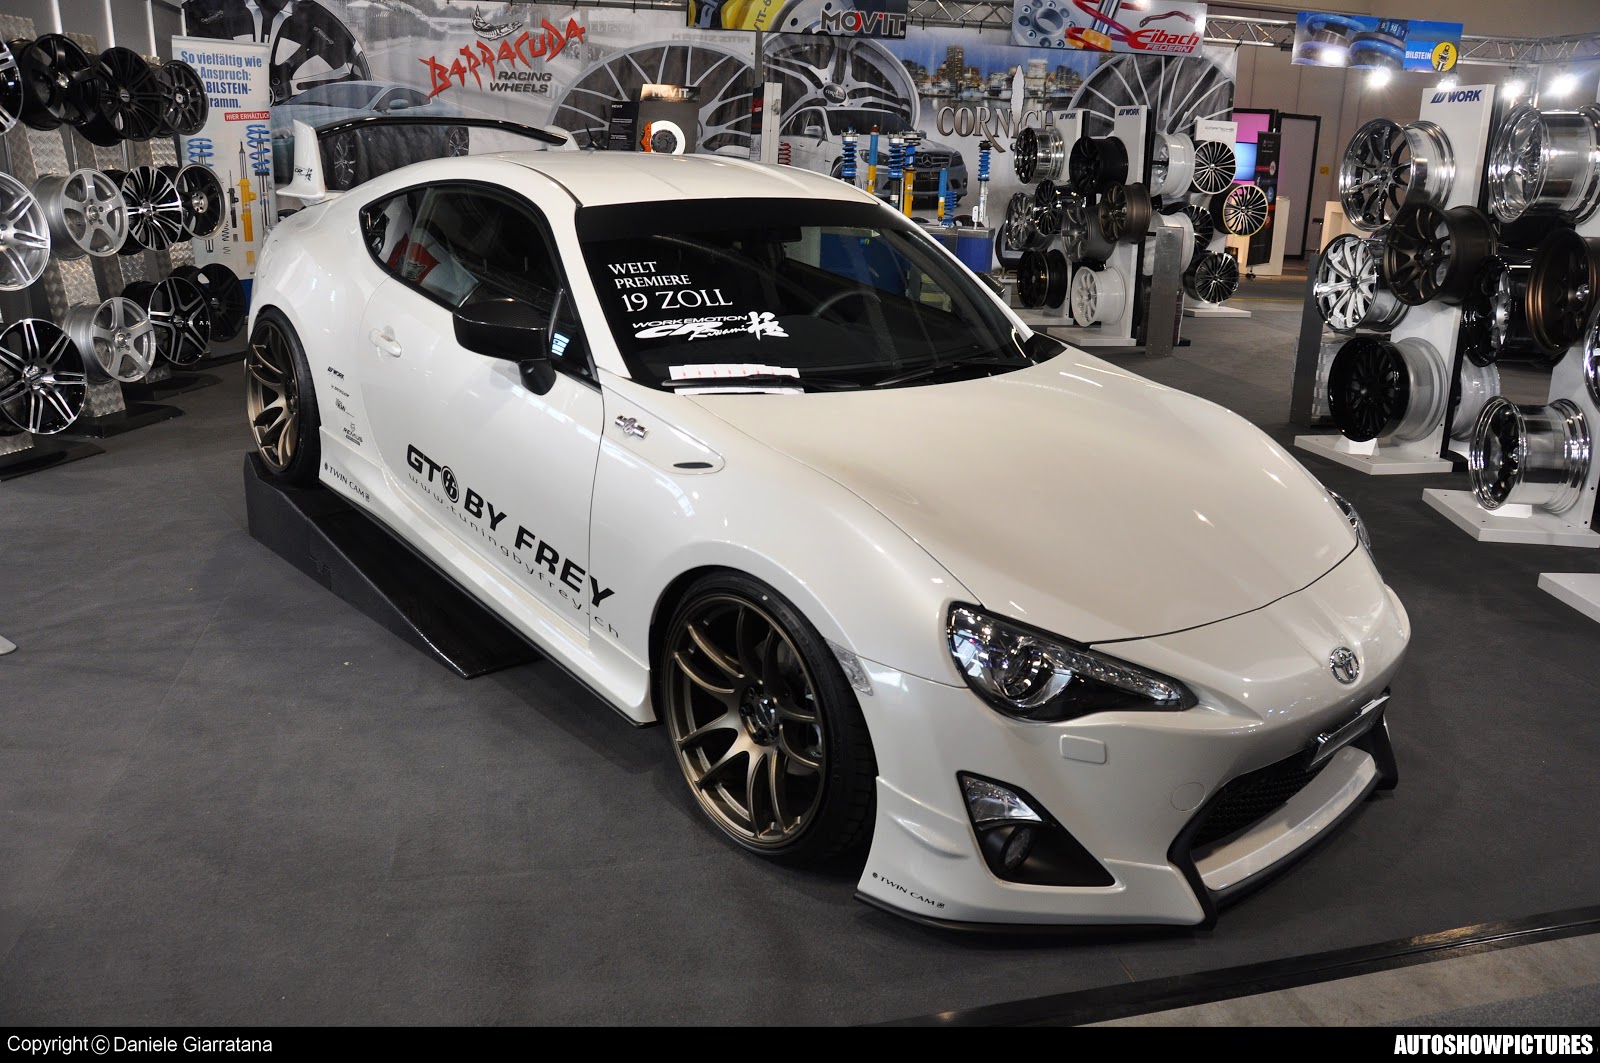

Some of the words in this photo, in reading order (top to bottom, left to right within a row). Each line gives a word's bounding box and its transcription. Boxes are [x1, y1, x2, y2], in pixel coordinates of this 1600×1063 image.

[1128, 28, 1200, 50] Eibach
[1145, 43, 1192, 53] FEDERN
[1405, 50, 1432, 60] BILSTEIN
[181, 50, 195, 64] So
[196, 52, 243, 68] vielfältig
[244, 55, 262, 68] wie
[417, 17, 586, 100] BARRACUDA
[200, 66, 252, 81] Anspruch:
[497, 71, 553, 82] RACING
[205, 81, 252, 95] BILSTEIN-
[489, 82, 549, 93] WHEELS
[209, 97, 242, 109] ramm.
[1447, 89, 1483, 103] WORK
[607, 261, 657, 275] WELT
[614, 274, 692, 289] PREMIERE
[621, 292, 648, 312] 19
[655, 288, 733, 309] ZOLL
[632, 319, 684, 329] WORK
[683, 315, 748, 325] EMOTION
[329, 465, 348, 485] TWIN
[349, 481, 365, 498] CAM
[464, 487, 507, 532] BY
[514, 524, 615, 608] FREY
[880, 875, 908, 894] TWIN
[910, 891, 935, 906] CAM
